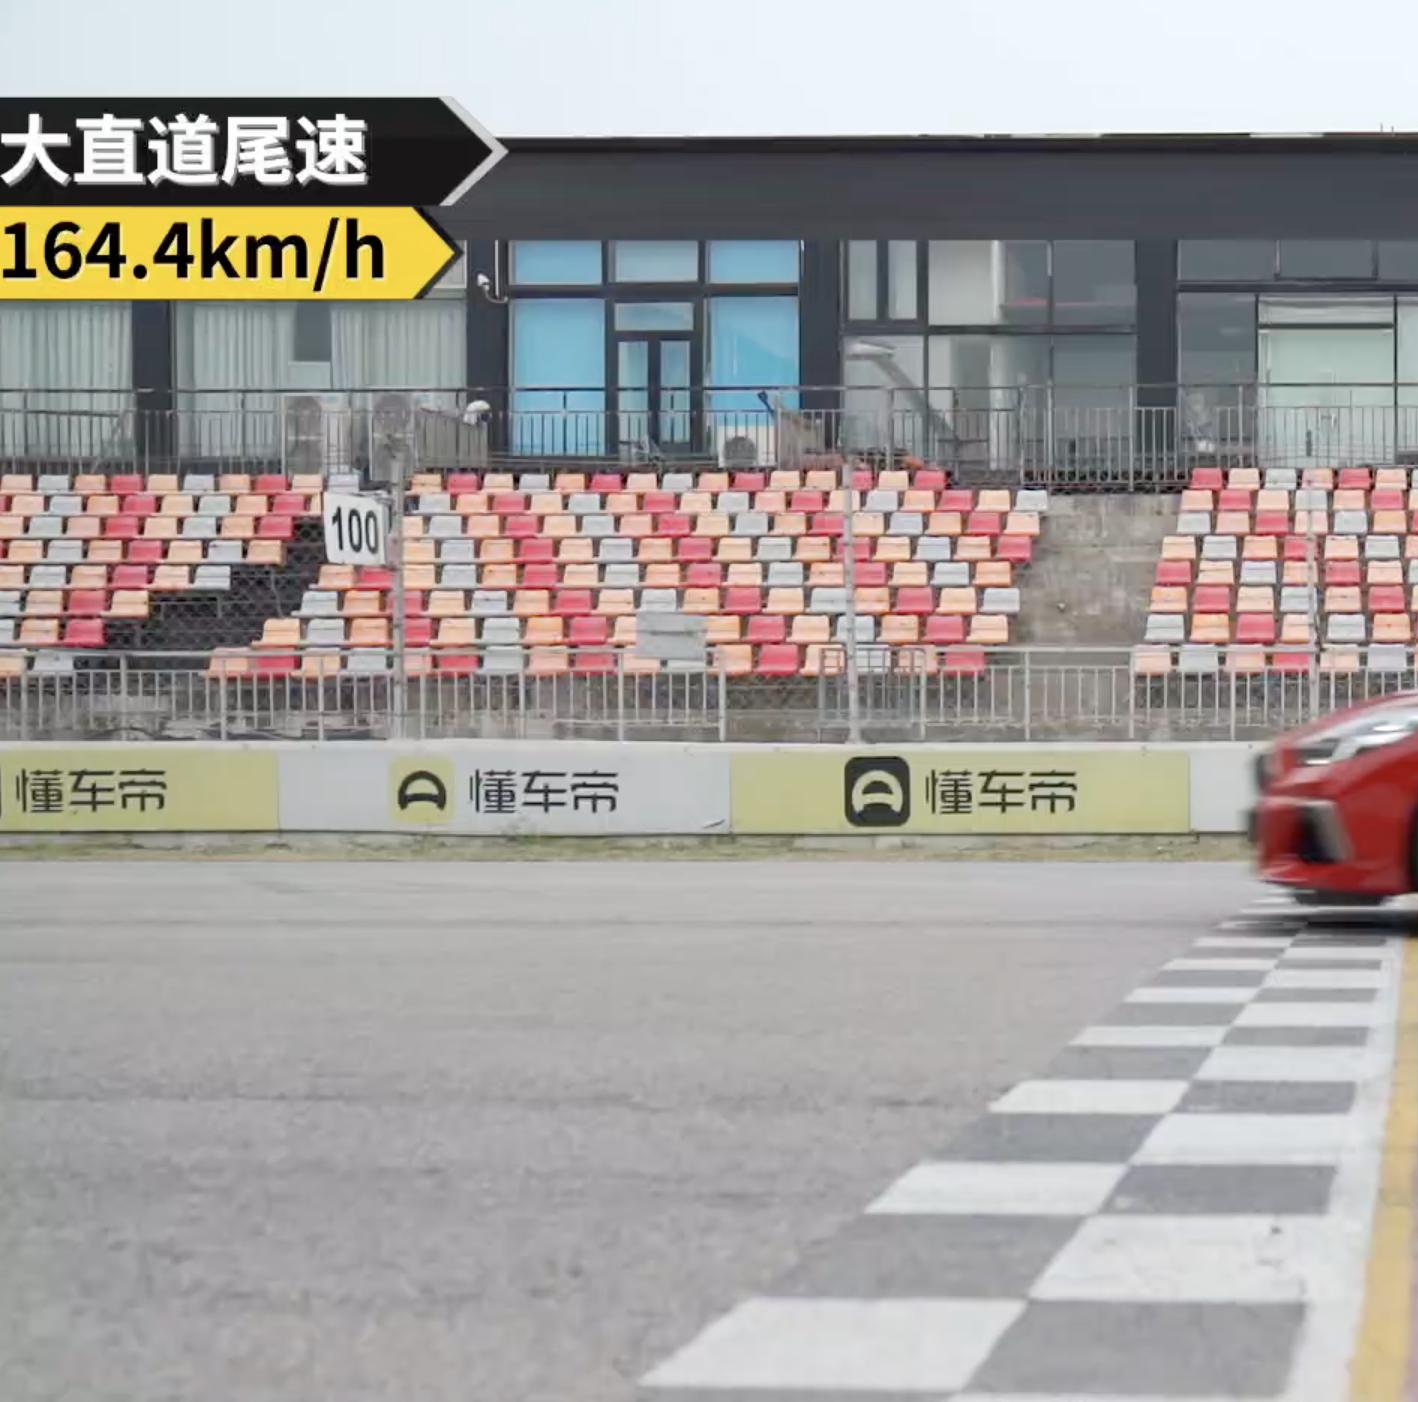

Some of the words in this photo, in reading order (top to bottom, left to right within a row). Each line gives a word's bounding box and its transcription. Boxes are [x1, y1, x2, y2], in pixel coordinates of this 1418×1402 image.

[331, 505, 380, 555] 100
[15, 768, 167, 814] 懂车帝
[469, 768, 619, 814] 懂车帝
[925, 768, 1078, 815] 懂车帝
